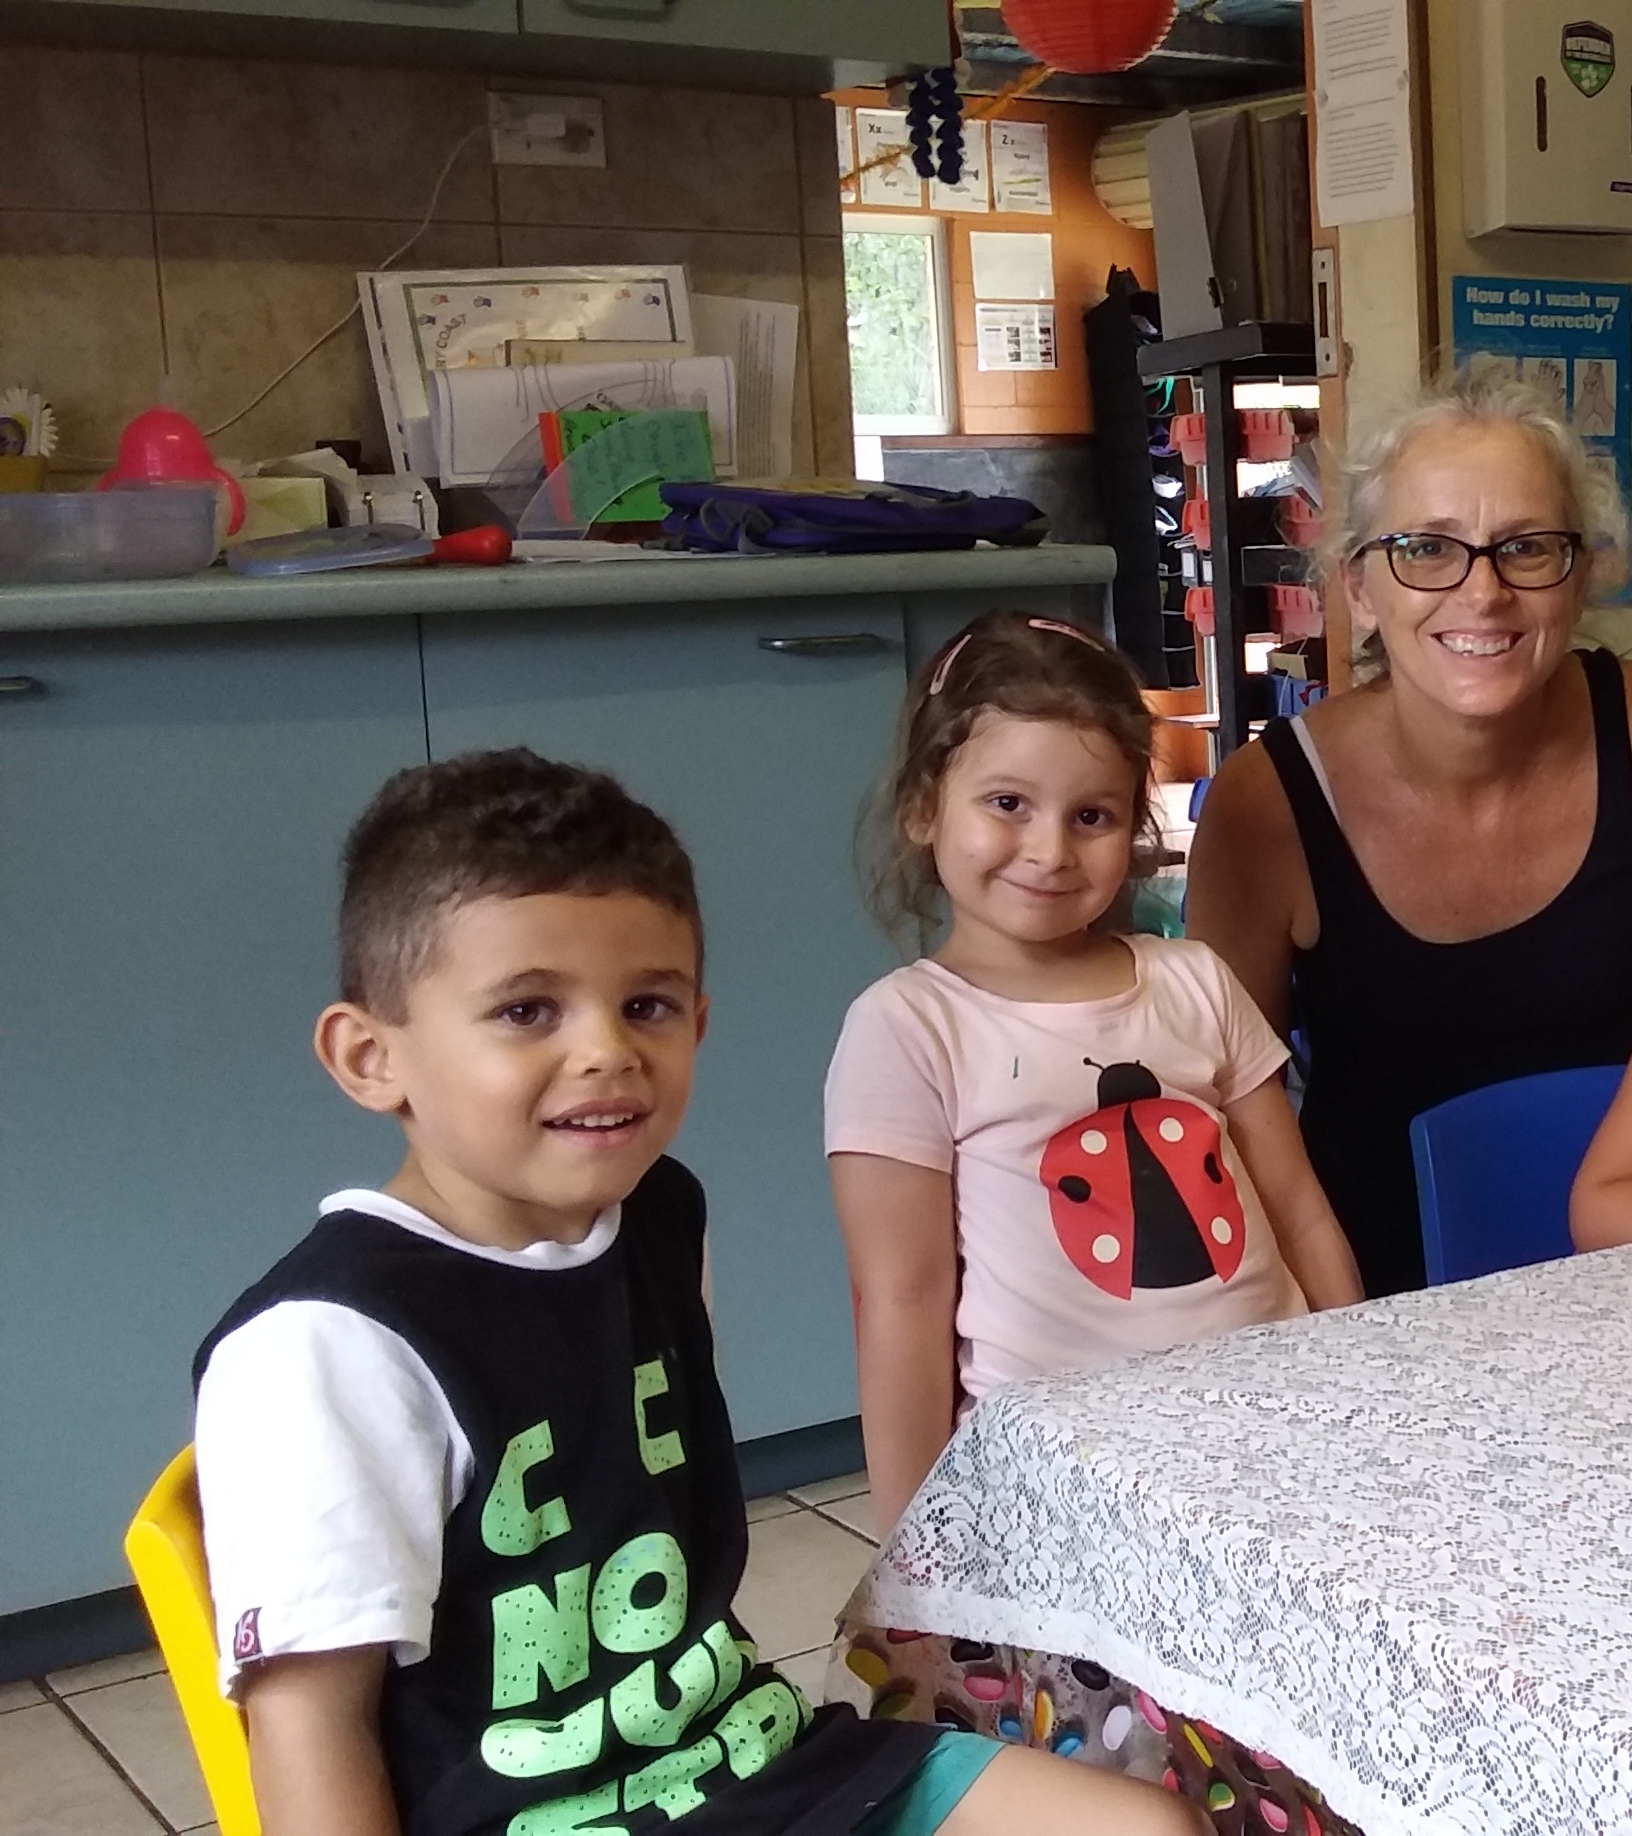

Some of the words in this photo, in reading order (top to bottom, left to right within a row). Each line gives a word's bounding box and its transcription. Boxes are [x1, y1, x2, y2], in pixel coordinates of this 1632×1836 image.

[1466, 286, 1504, 304] How
[1509, 288, 1530, 305] do
[1536, 290, 1542, 306] I
[1546, 292, 1590, 308] wash
[1596, 295, 1620, 313] my
[1473, 309, 1525, 327] hands
[1530, 312, 1614, 334] correctly?
